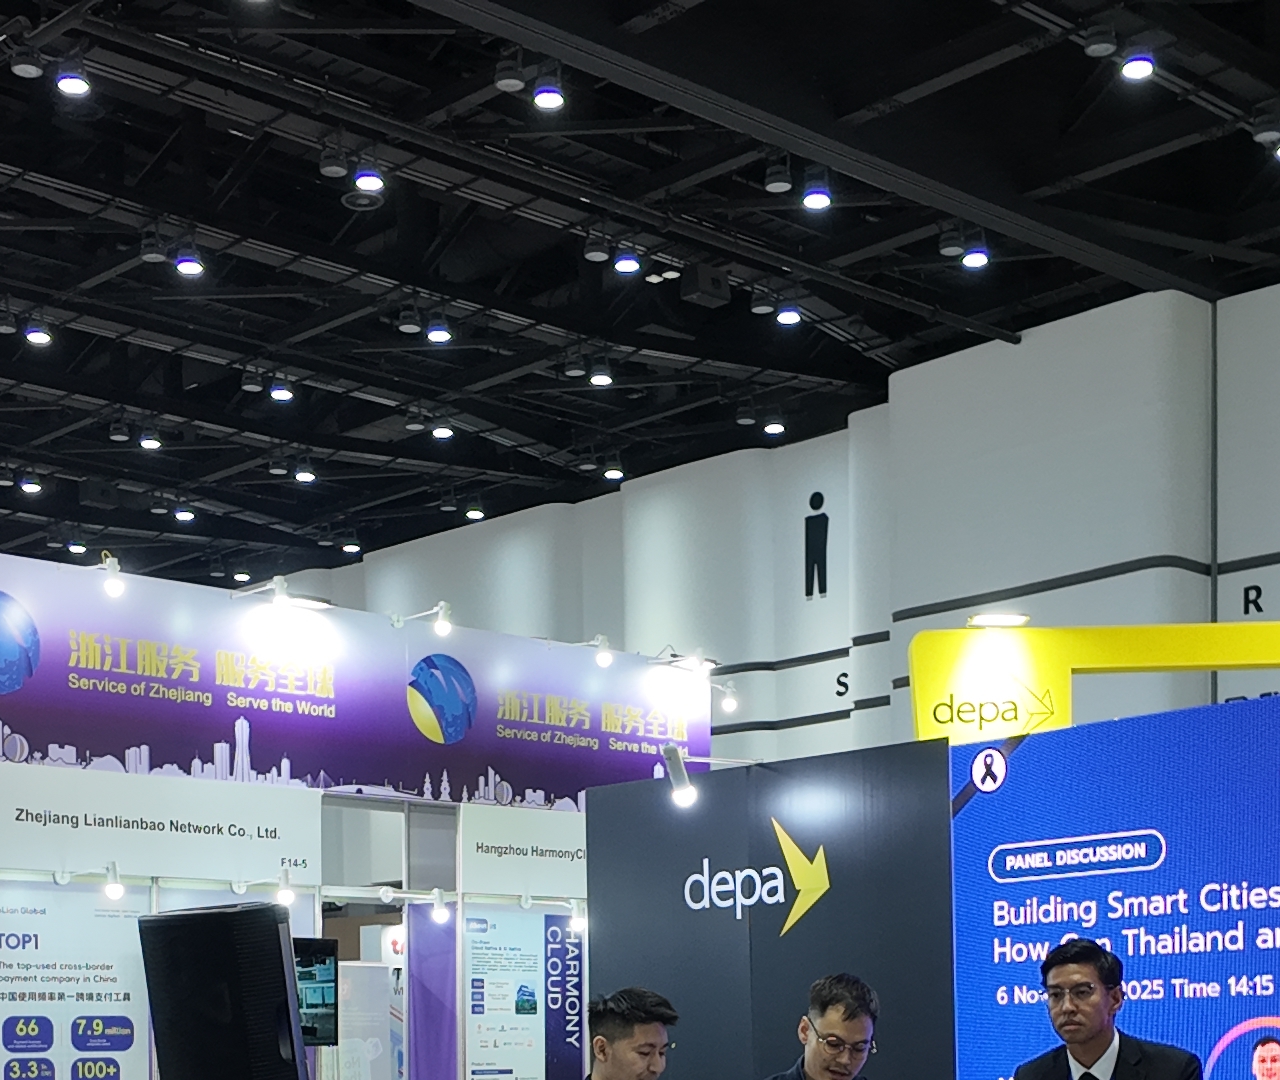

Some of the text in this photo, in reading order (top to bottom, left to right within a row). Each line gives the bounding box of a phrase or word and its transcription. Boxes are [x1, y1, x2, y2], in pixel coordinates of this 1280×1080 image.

[1243, 584, 1264, 615] R
[68, 630, 201, 682] 浙江服务
[68, 673, 336, 718] Service of Zhejiang Serve the World
[835, 673, 850, 696] S
[496, 690, 591, 730] 浙江服务
[932, 694, 1019, 731] depa
[496, 725, 538, 742] Service
[541, 730, 552, 743] of
[553, 732, 599, 750] Zhejiang
[609, 738, 639, 753] Serve
[641, 742, 657, 755] the
[15, 808, 80, 829] Zhejiang
[83, 812, 166, 833] Lianlianbao
[169, 817, 224, 837] Network
[257, 825, 281, 840] Ltd.
[280, 858, 308, 869] F14-5
[475, 842, 529, 859] Hangzhou
[1005, 842, 1147, 871] PANEL DISCUSSION
[684, 857, 786, 920] depa
[992, 896, 1097, 928] Building
[1107, 889, 1188, 920] Smart
[993, 937, 1050, 963] How
[1121, 921, 1244, 957] Thailand
[17, 962, 57, 972] top-used
[59, 962, 114, 971] cross-border
[41, 975, 81, 984] company
[83, 974, 91, 983] in
[93, 975, 118, 983] China
[547, 926, 562, 1009] CLOUD
[565, 926, 580, 1049] HARMONY
[996, 986, 1009, 1005] 6
[1171, 978, 1220, 998] Time
[1227, 974, 1274, 997] 14:15
[16, 1018, 39, 1036] 66
[76, 1019, 103, 1036] 7.9
[9, 1061, 39, 1079] 3.3
[76, 1061, 117, 1079] 100+
